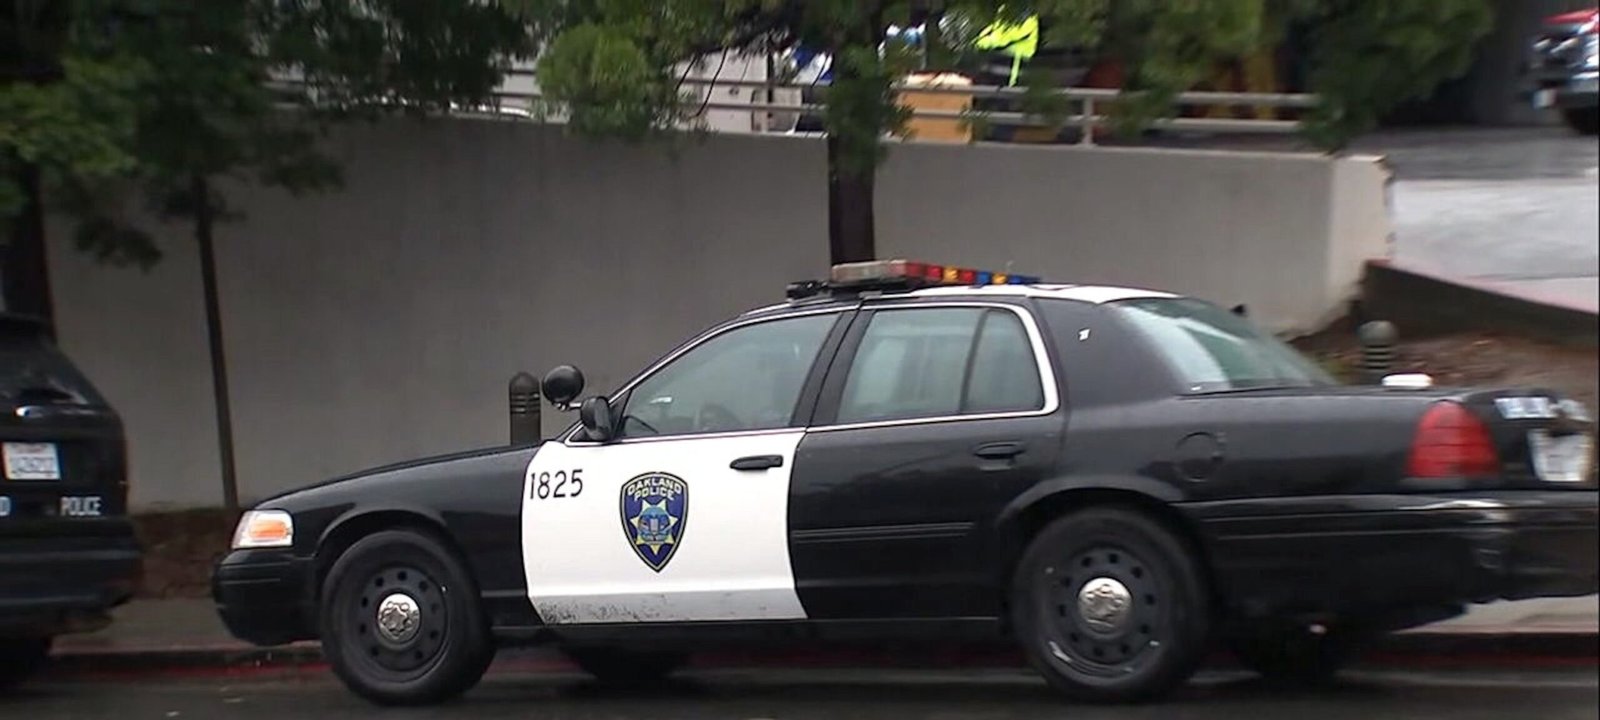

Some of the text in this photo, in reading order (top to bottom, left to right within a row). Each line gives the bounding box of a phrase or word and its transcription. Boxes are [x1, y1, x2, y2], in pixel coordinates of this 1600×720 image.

[530, 469, 583, 500] 1825
[627, 477, 682, 496] OAKLAND
[634, 486, 675, 502] POLICE
[60, 496, 101, 516] POLICE
